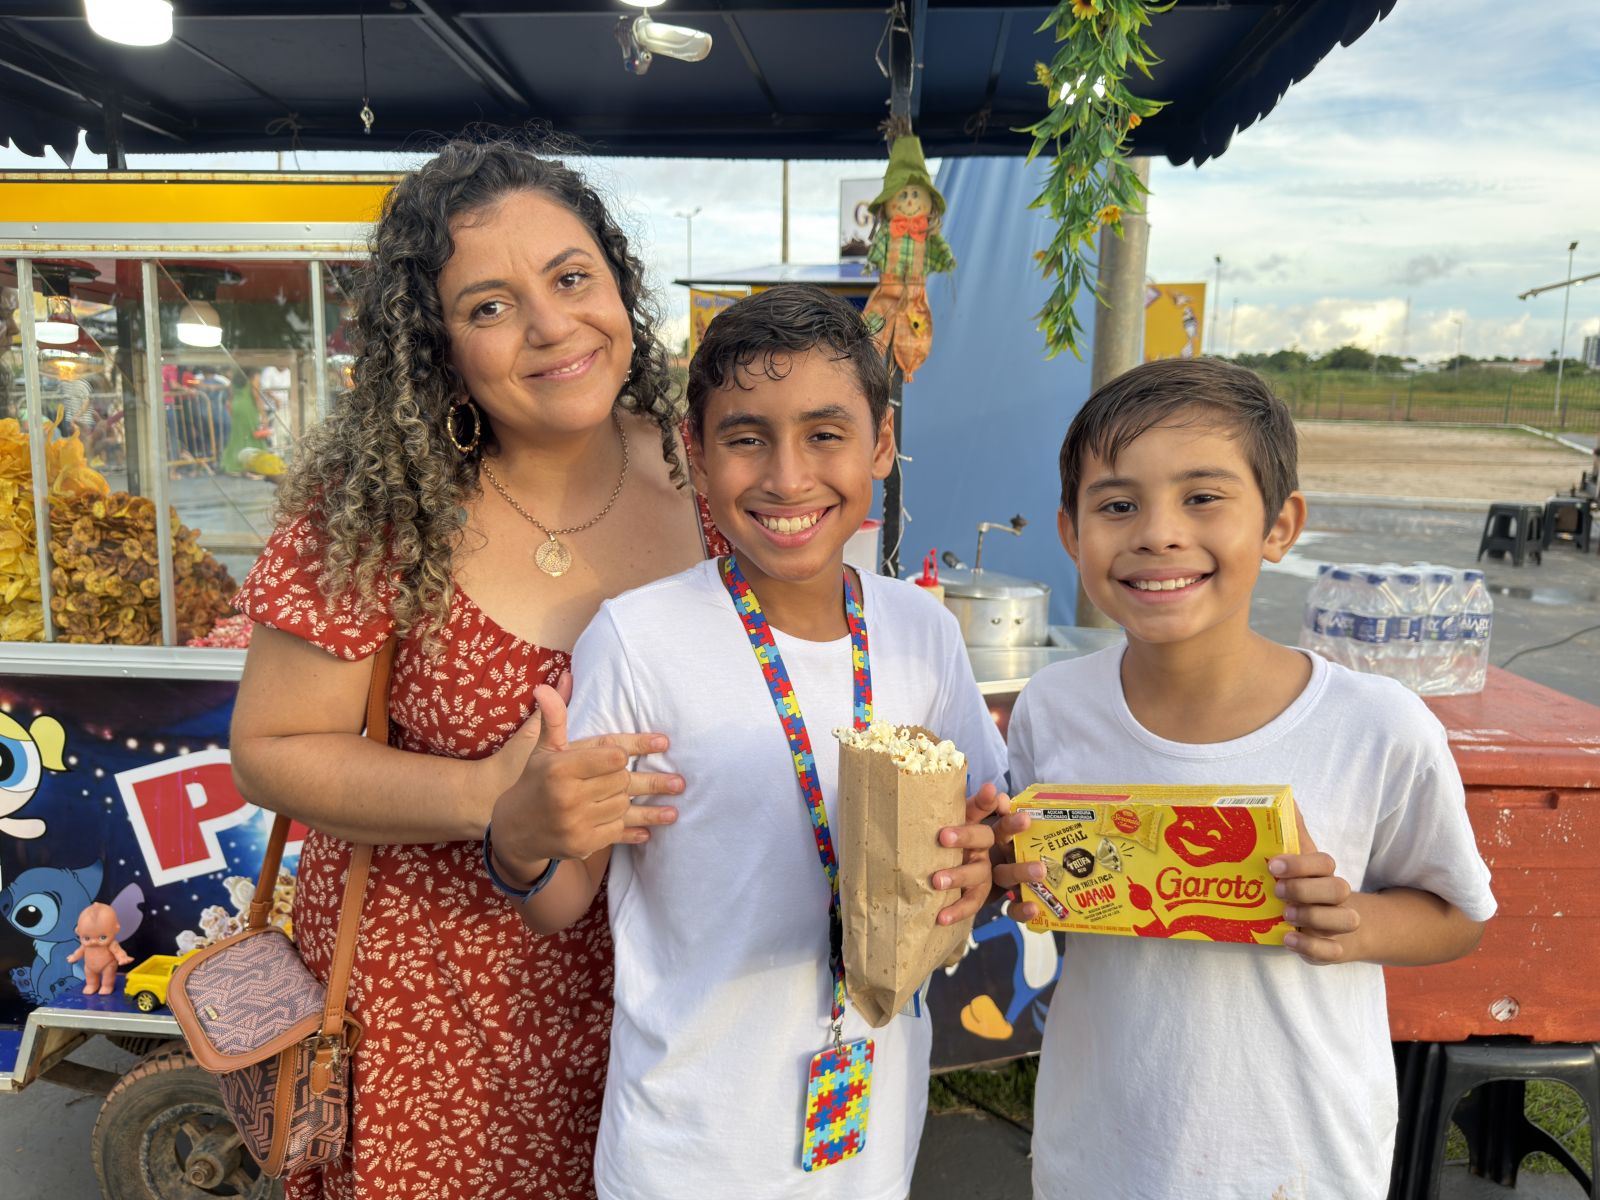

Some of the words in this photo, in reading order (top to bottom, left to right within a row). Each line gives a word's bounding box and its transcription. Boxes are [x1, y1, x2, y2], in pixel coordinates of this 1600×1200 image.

[1054, 830, 1088, 848] LEGAL
[1067, 856, 1091, 870] TRUFA
[1155, 866, 1264, 901] Garoto
